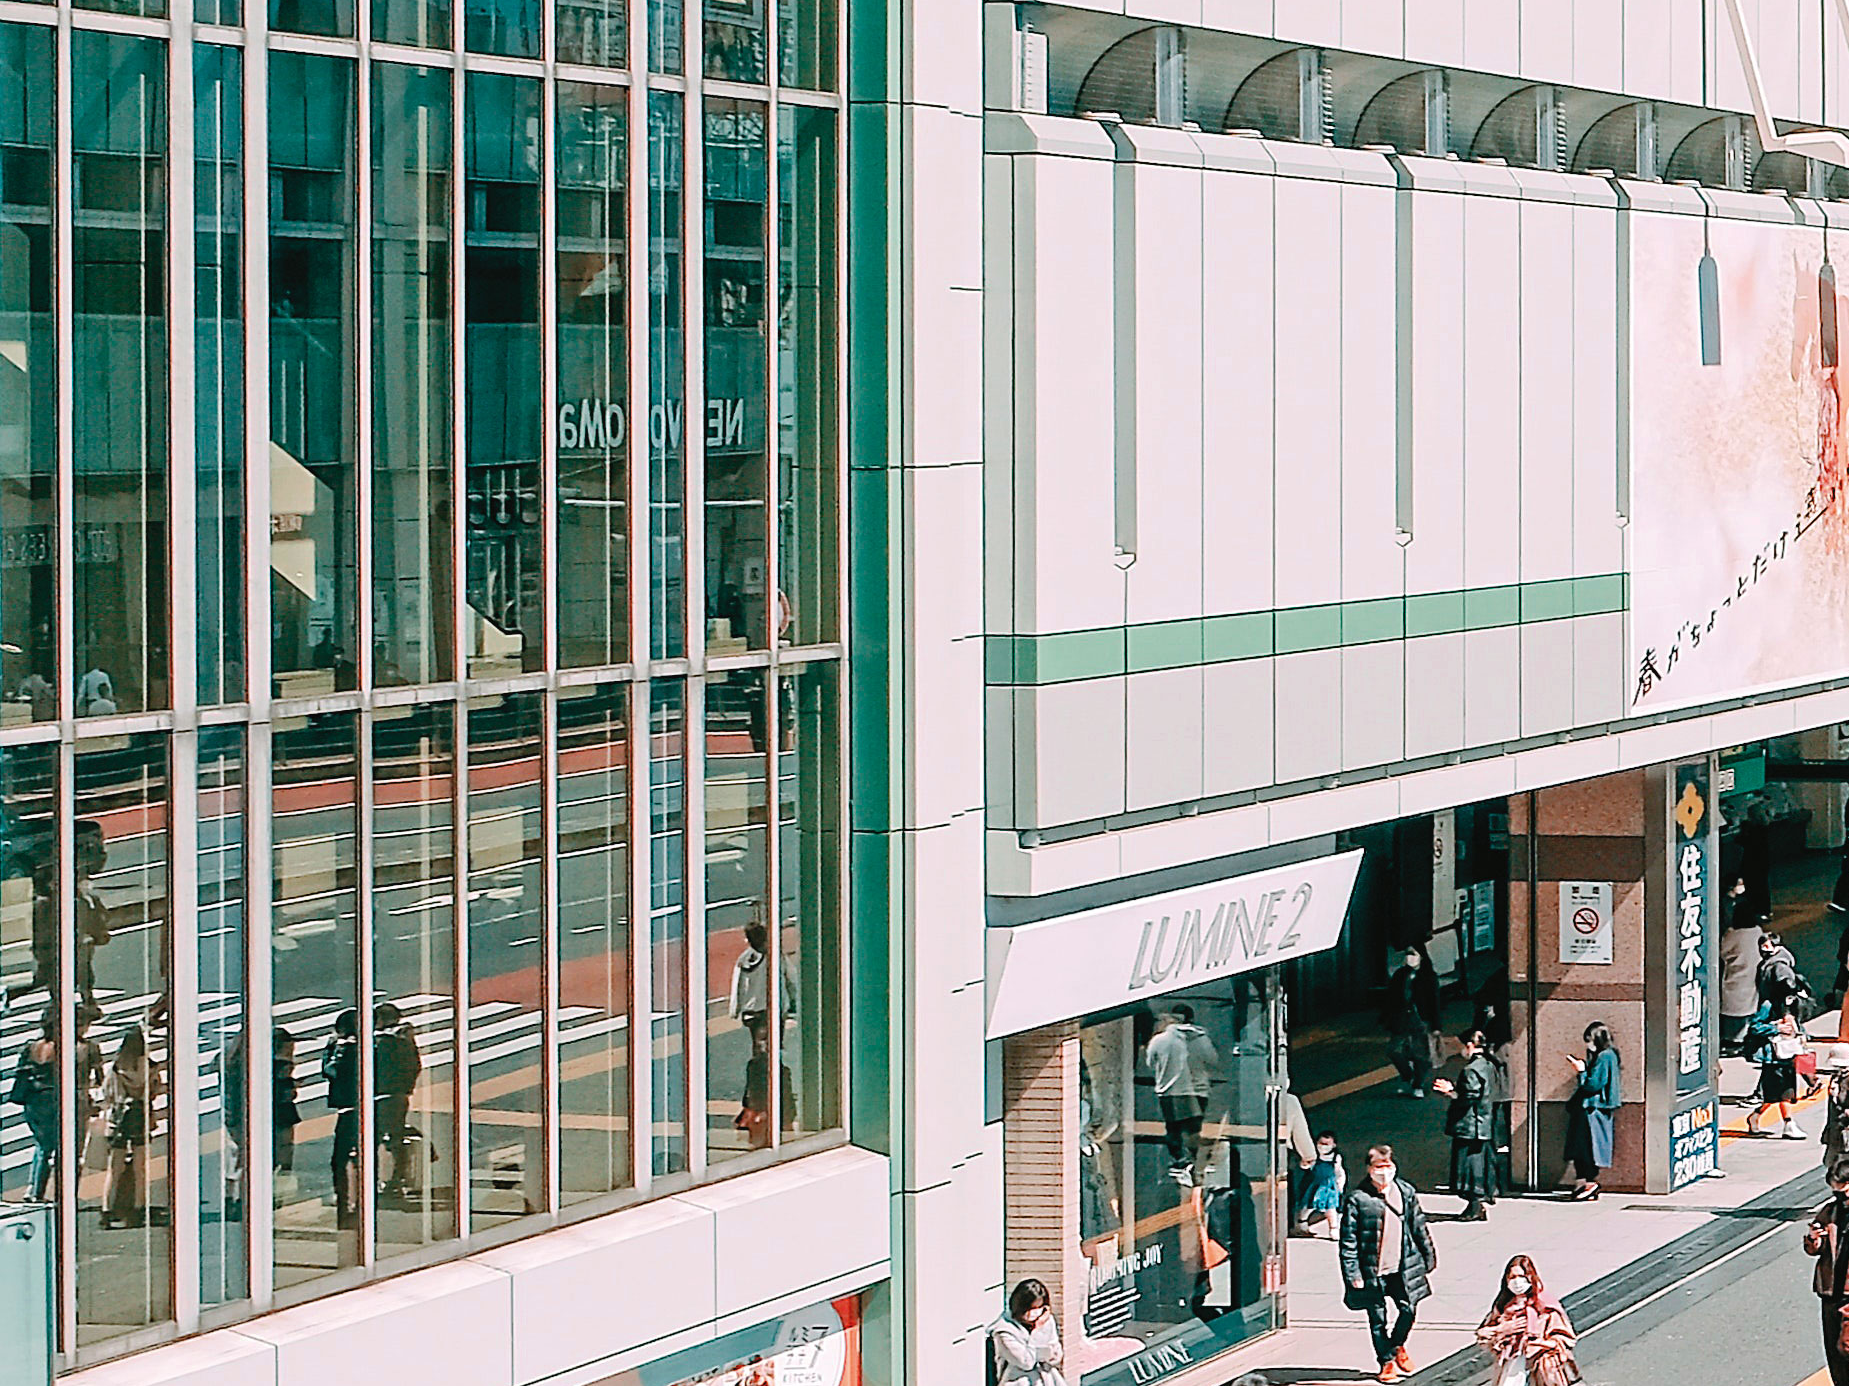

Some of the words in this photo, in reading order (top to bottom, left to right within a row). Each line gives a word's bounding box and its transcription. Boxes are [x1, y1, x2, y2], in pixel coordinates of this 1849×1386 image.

[1128, 889, 1287, 991] LUMINE
[1277, 881, 1313, 951] 2
[1678, 844, 1705, 1075] 住友不動産
[782, 1372, 823, 1384] KITCHEN
